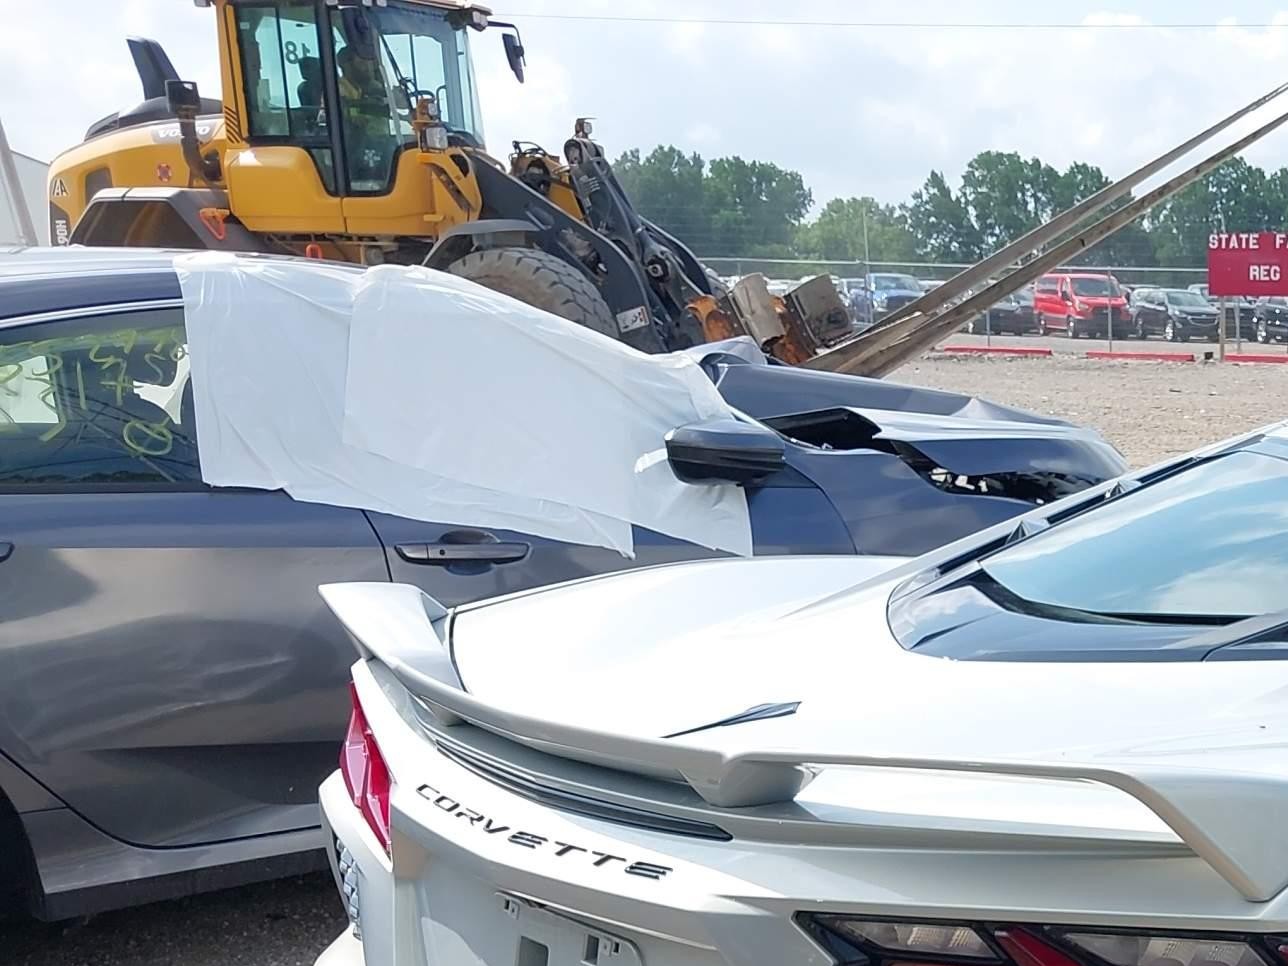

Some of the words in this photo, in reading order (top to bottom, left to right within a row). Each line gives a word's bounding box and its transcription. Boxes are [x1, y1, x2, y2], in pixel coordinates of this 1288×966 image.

[1209, 233, 1259, 249] STATE
[1249, 265, 1281, 281] REG
[415, 783, 674, 881] CORVETTE
